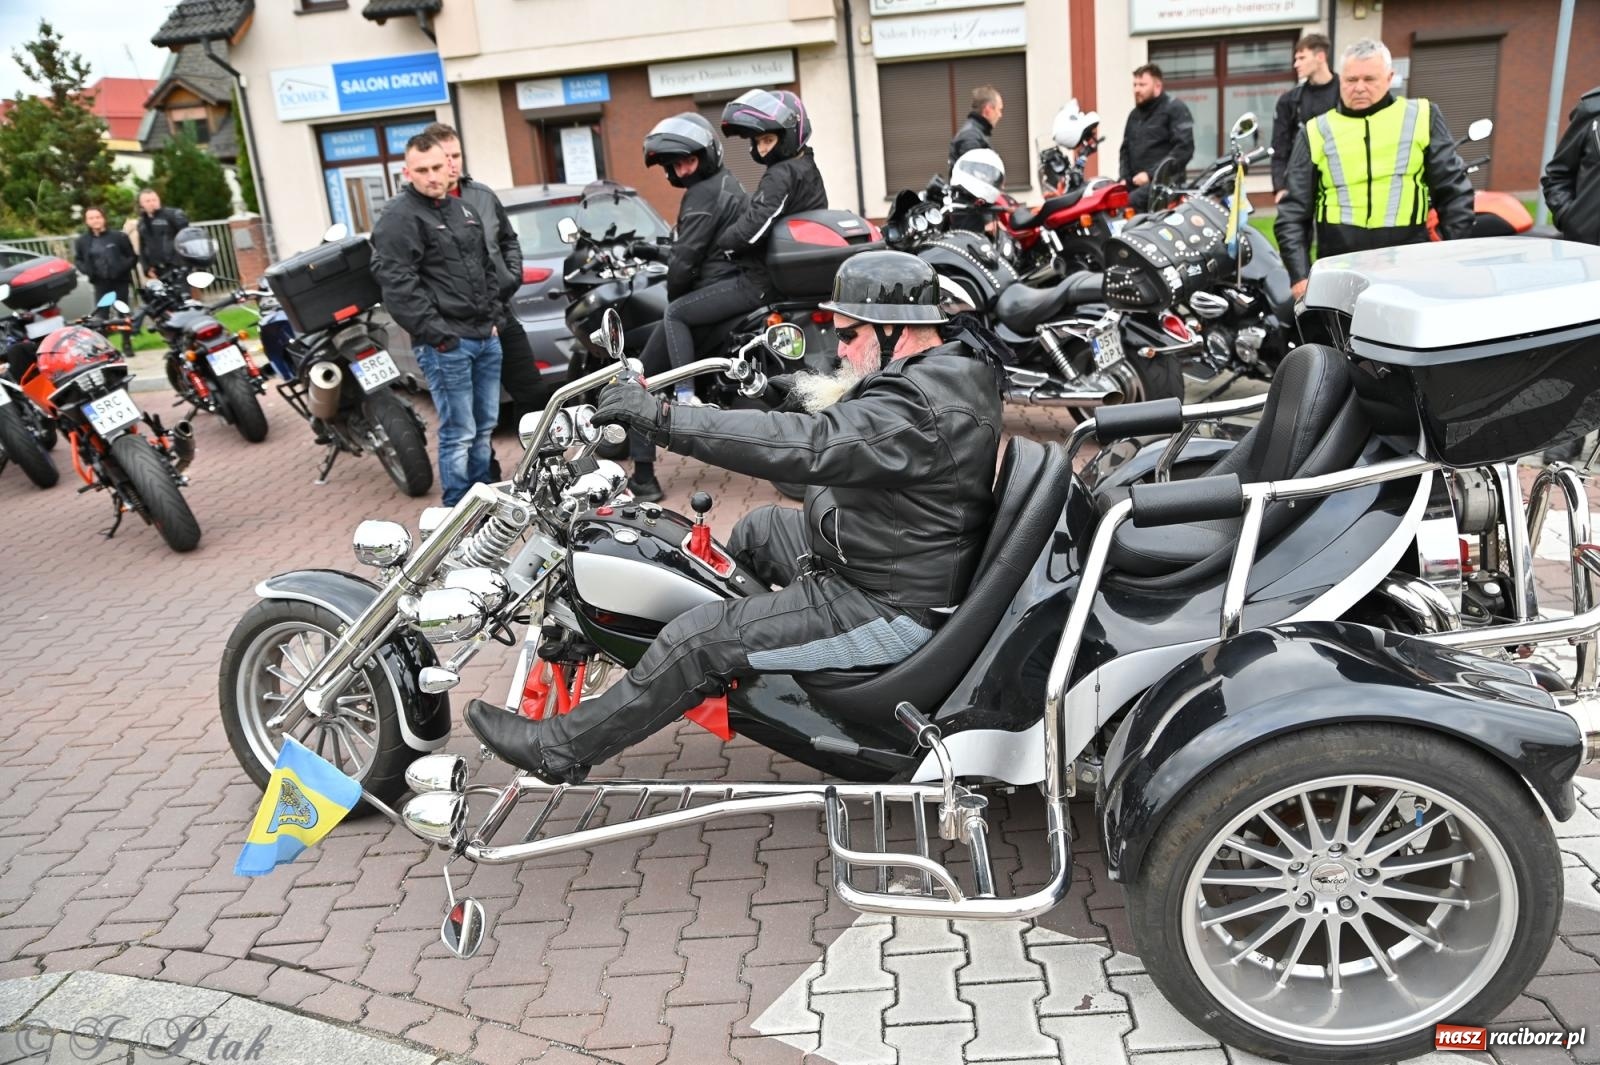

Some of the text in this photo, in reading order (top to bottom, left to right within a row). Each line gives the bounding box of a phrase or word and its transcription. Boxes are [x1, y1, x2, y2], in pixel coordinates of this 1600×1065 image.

[340, 70, 439, 95] SALON DRZWI
[361, 355, 385, 372] SRC
[363, 365, 396, 386] A30A
[95, 395, 122, 414] SRC
